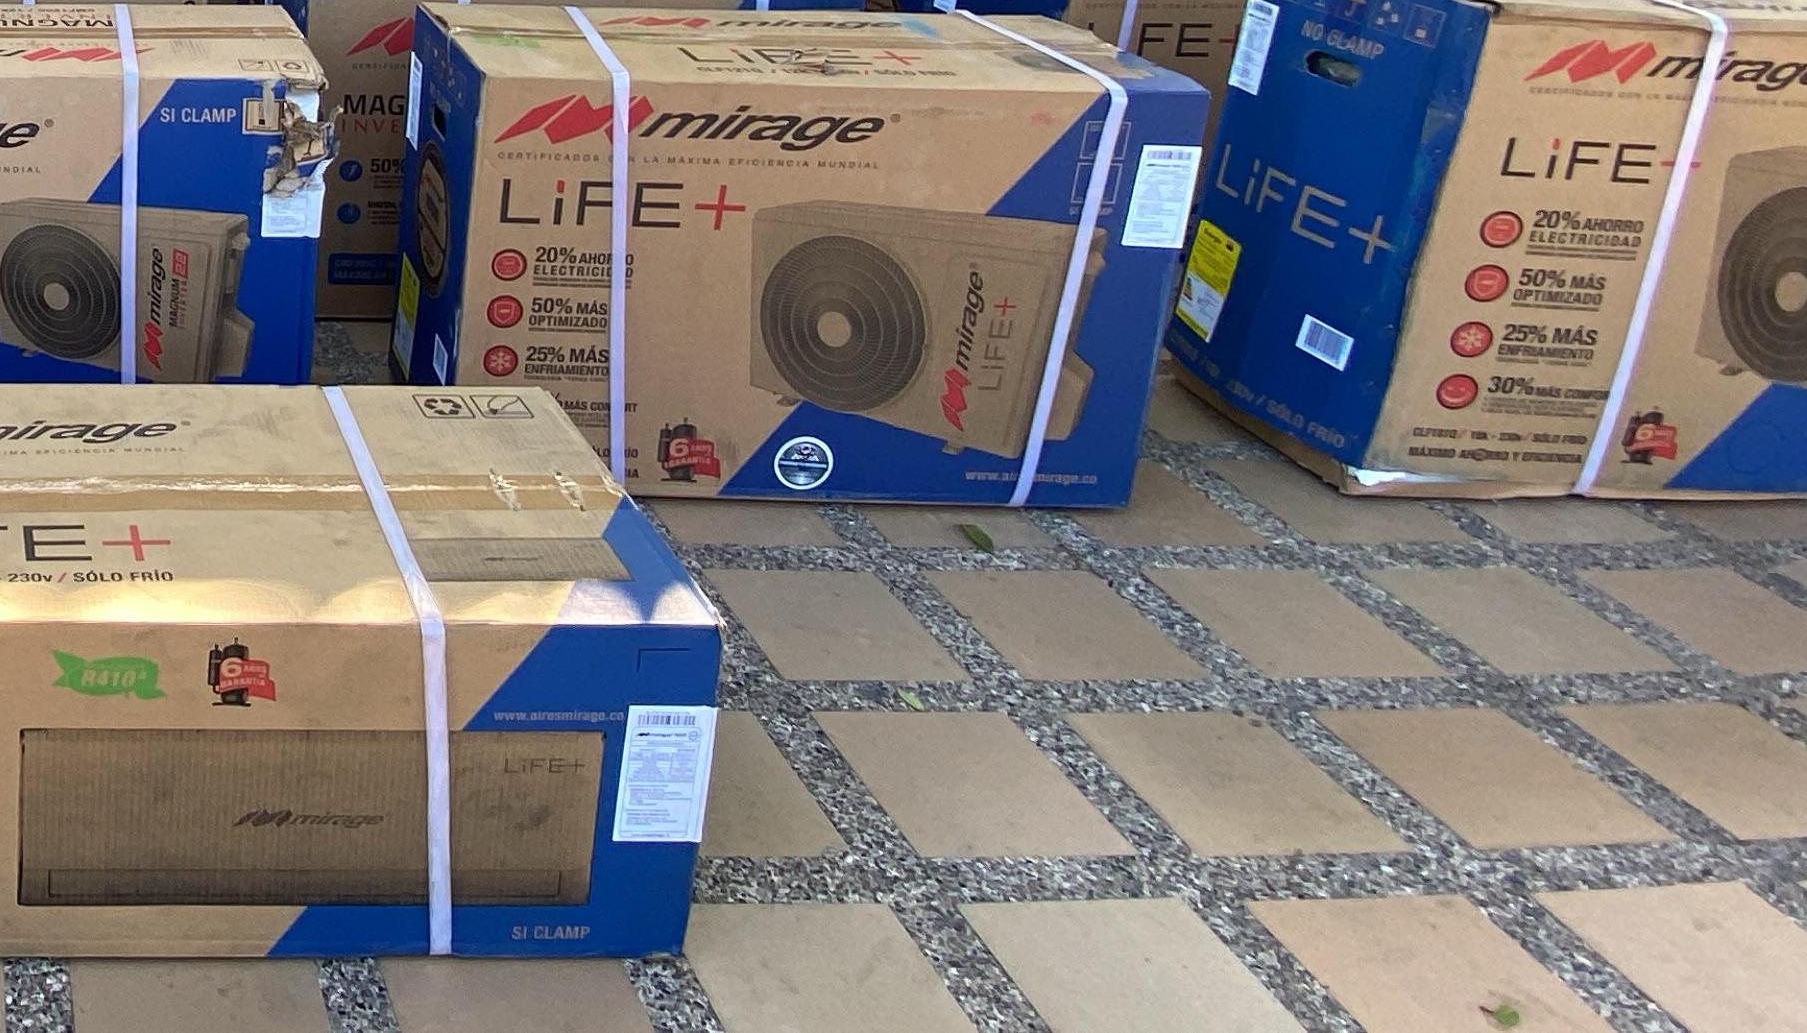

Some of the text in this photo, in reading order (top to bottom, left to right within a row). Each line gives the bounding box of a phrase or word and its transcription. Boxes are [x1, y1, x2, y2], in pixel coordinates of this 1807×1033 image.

[1300, 20, 1385, 60] NO CLAMP
[160, 107, 238, 123] SI CLAMP
[638, 105, 886, 152] mirage
[497, 151, 600, 163] CERTIFICADOS
[728, 157, 810, 169] EFICIENCIA
[816, 159, 881, 170] MUNDIAL
[498, 178, 748, 232] LiFE+
[1216, 143, 1395, 265] LiFE+
[1533, 209, 1645, 234] 20% AHORRO
[1528, 231, 1642, 248] ELECTRICIDAD
[534, 246, 577, 265] 20%
[145, 248, 169, 325] mirage
[1518, 267, 1606, 291] 50% MÁS
[168, 278, 180, 328] MAGNUM
[530, 297, 608, 316] 50% MÁS
[1512, 289, 1604, 306] OPTIMIZADO
[528, 315, 608, 329] OPTIMIZADO
[954, 270, 985, 372] mirage
[1502, 323, 1599, 346] 25% MÁS
[525, 344, 610, 364] 25% MÁS
[1497, 343, 1595, 360] ENFRIAMIENTO
[524, 363, 610, 378] ENFRIAMIENTO
[1487, 376, 1535, 396] 30%
[668, 438, 690, 457] 6
[7, 571, 52, 583] 230v
[72, 568, 124, 583] SÓLO
[129, 567, 175, 582] FRÍO
[221, 657, 242, 677] 6
[493, 709, 625, 723] www.airesmirage.co
[286, 808, 385, 831] mirage
[511, 925, 591, 940] SI CLAMP
